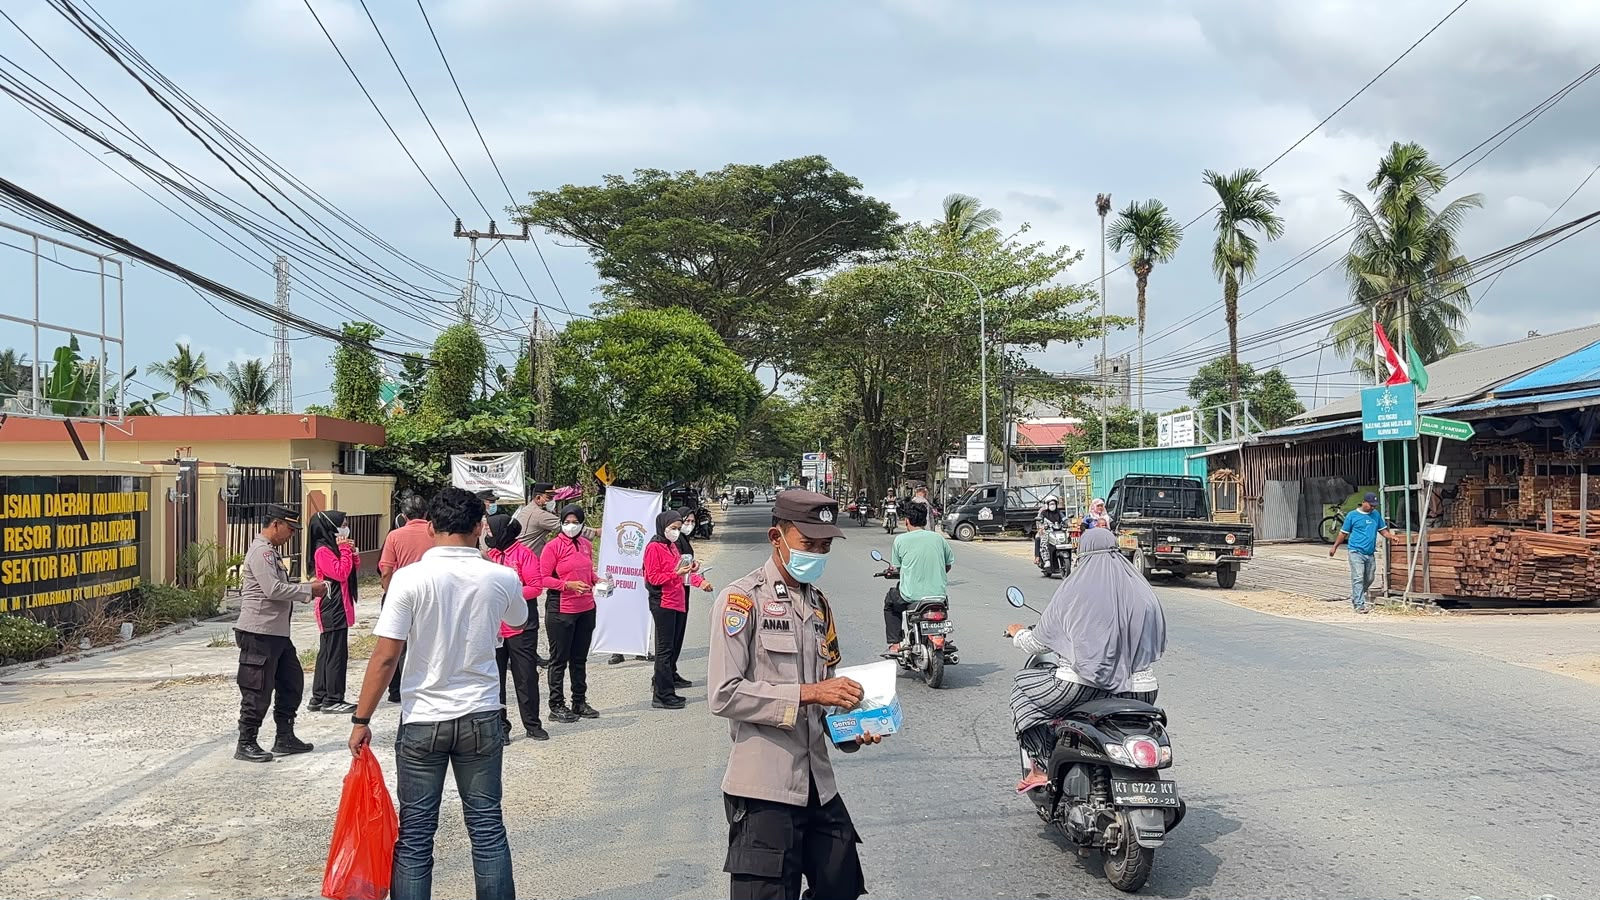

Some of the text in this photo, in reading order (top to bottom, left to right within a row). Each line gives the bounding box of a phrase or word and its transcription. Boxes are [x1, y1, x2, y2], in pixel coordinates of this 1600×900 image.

[44, 492, 90, 517] DAERAH
[93, 492, 135, 516] KALIMANTAN
[4, 519, 136, 552] RESOR KOTA BALIKPAPAN
[1, 555, 58, 585] SEKTOR
[615, 580, 637, 589] PEDULI
[763, 619, 790, 630] ANAM
[1115, 782, 1173, 794] KT 6722 KY
